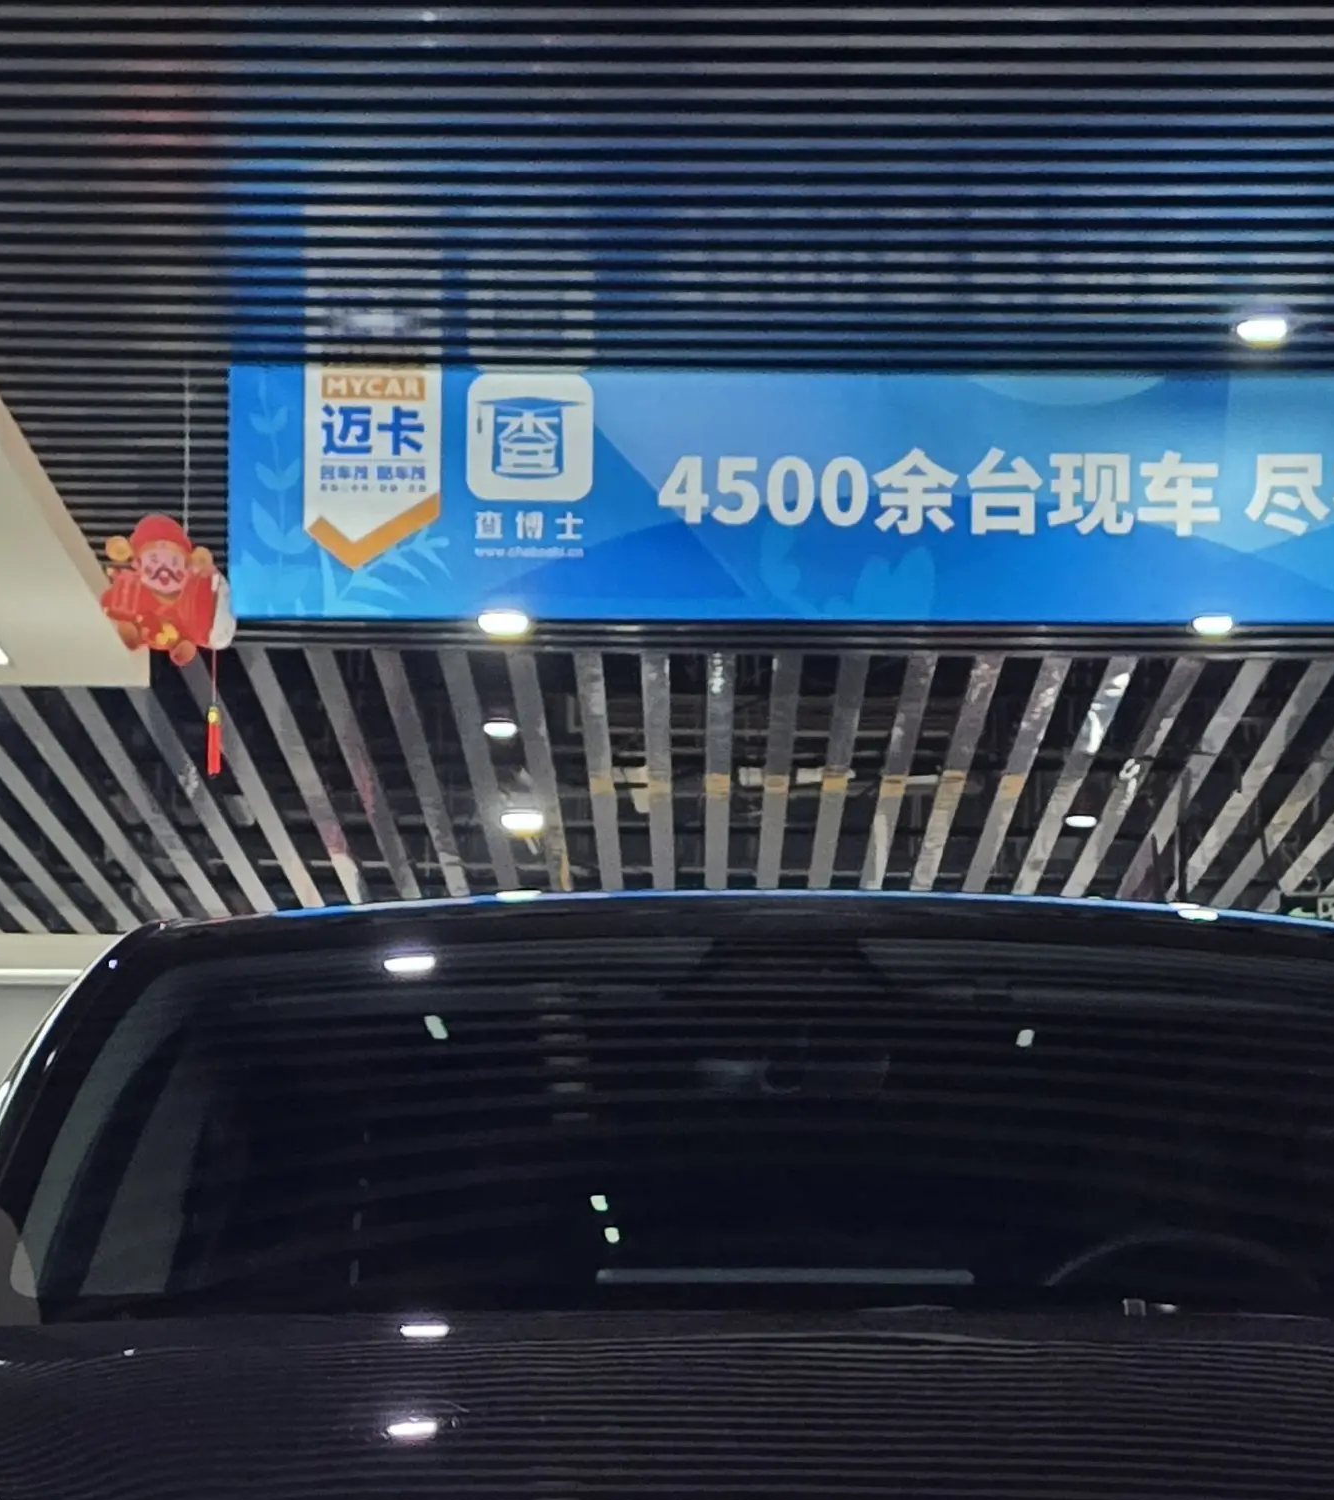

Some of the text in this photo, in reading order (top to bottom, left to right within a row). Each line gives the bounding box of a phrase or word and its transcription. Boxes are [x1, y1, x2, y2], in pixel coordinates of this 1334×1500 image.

[325, 376, 422, 398] MYCAR
[320, 405, 426, 457] 迈卡
[658, 447, 1220, 536] 4500余台现车
[474, 511, 585, 541] 查博士
